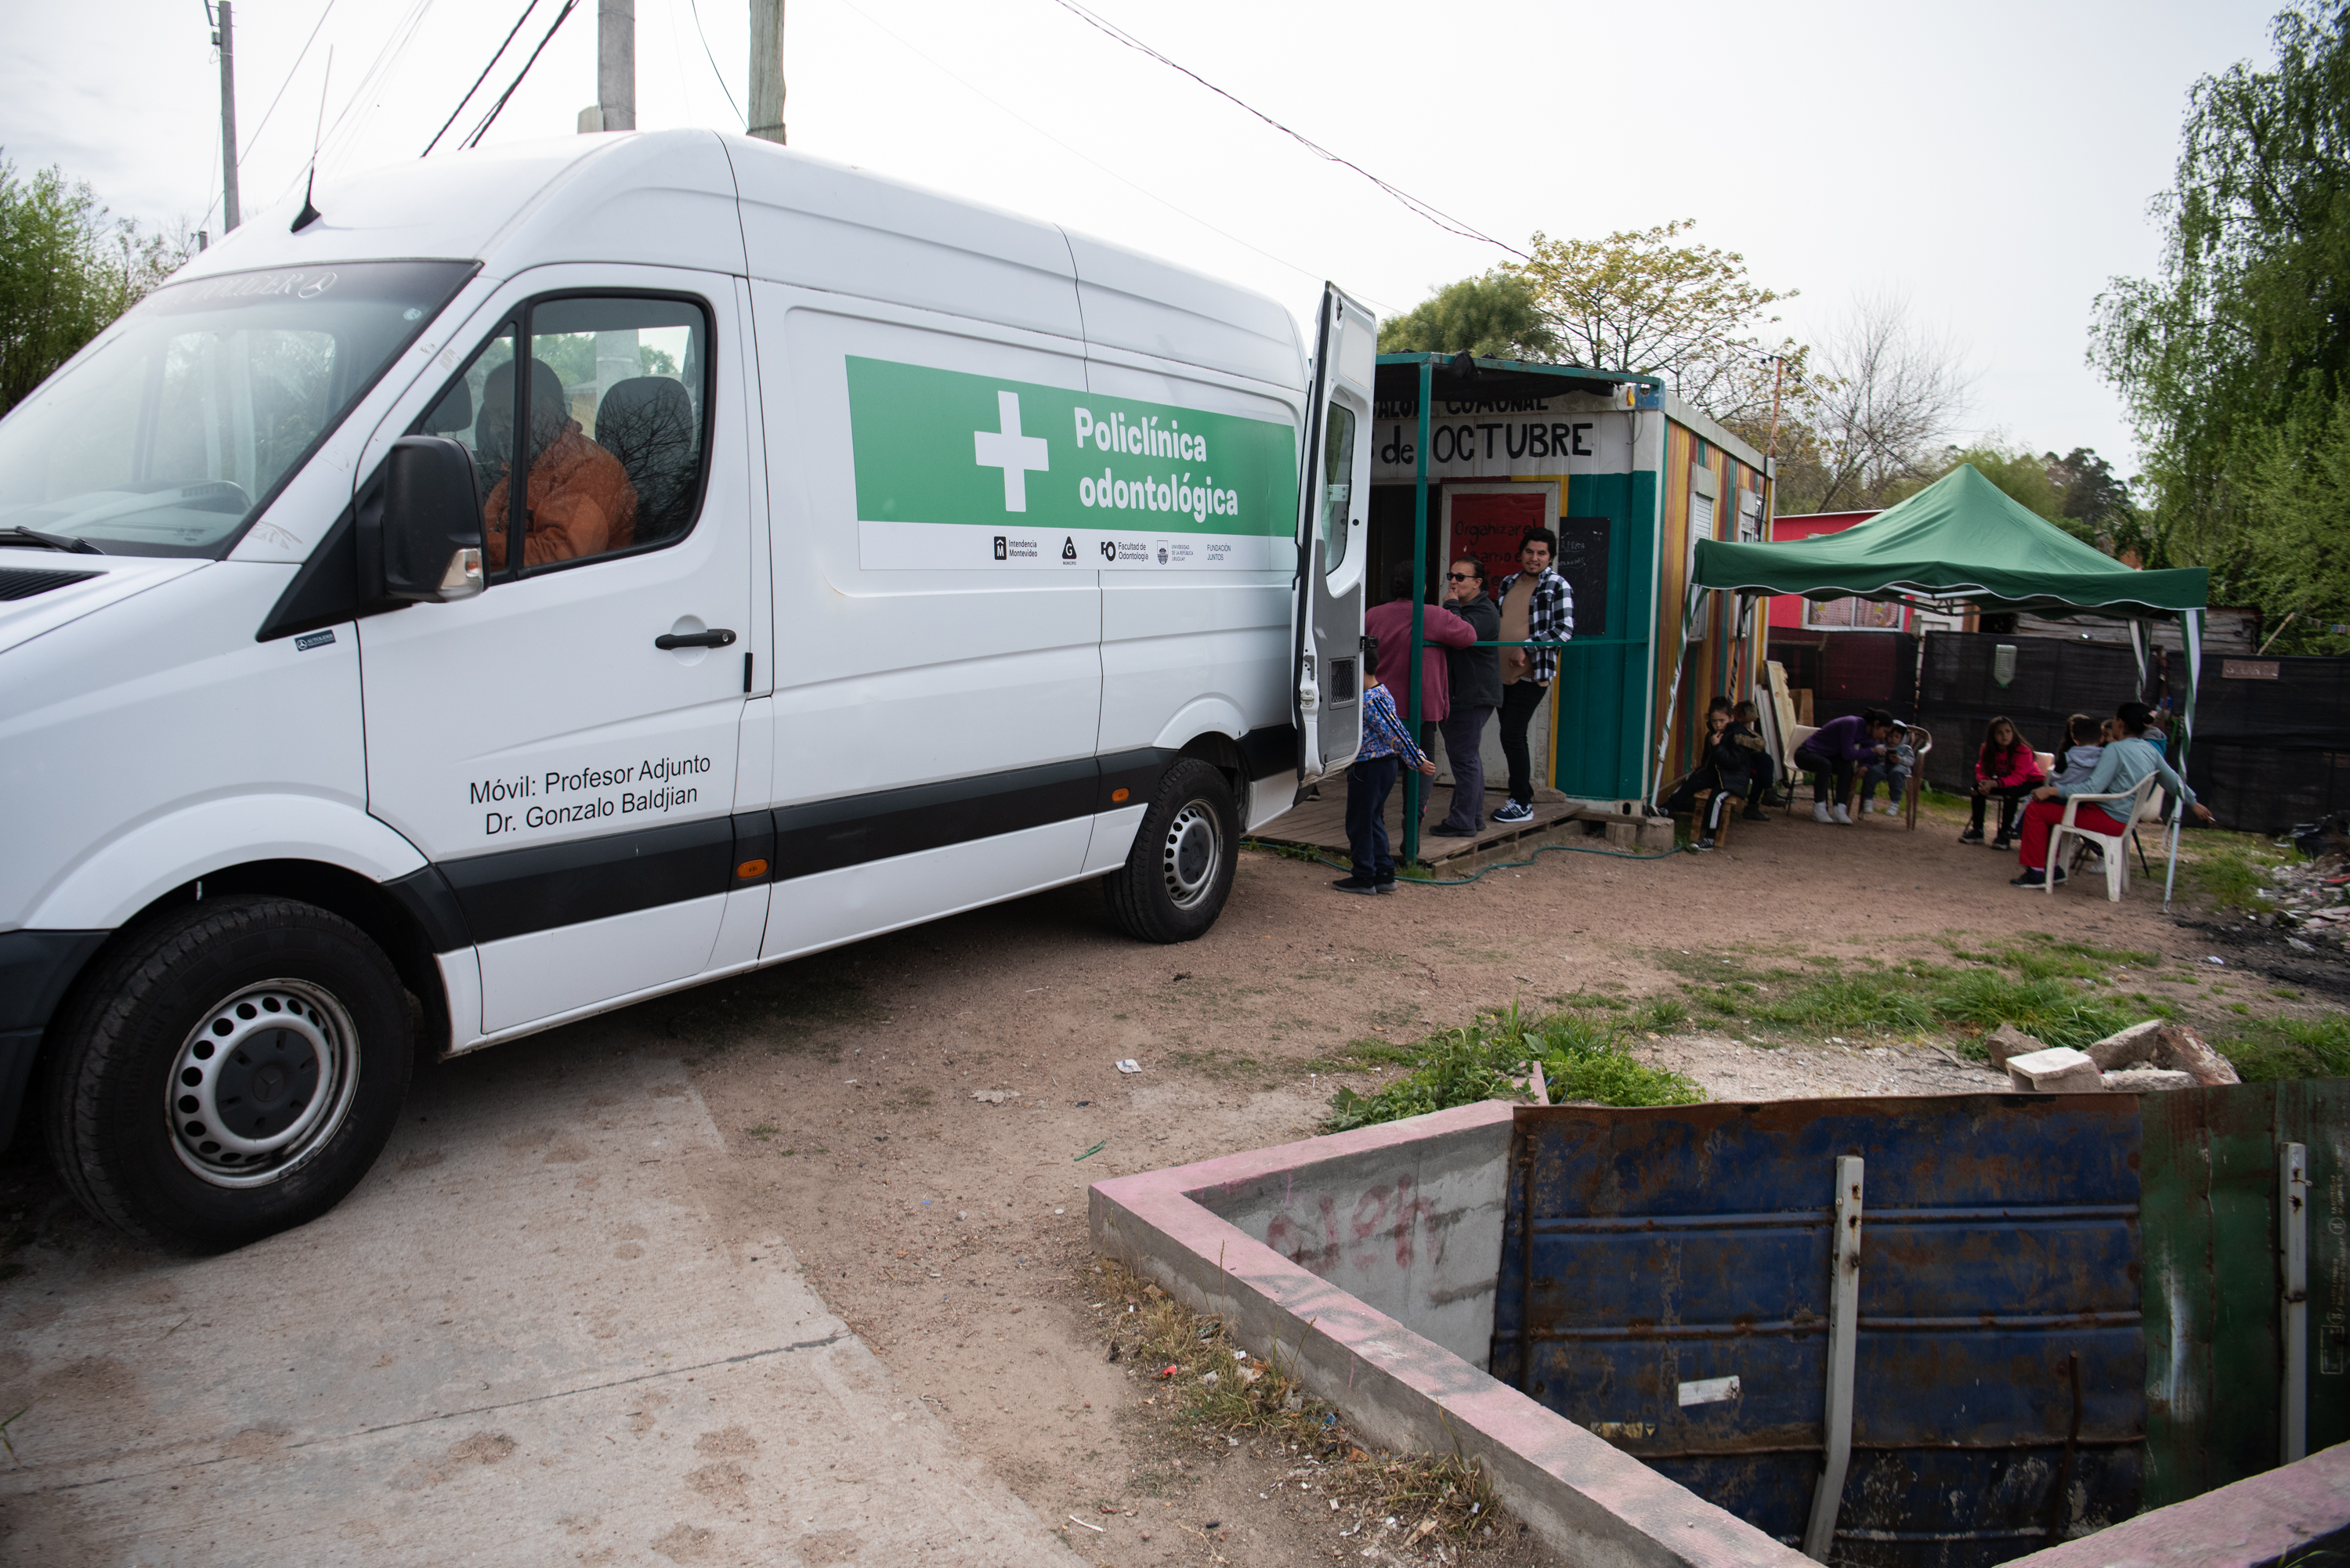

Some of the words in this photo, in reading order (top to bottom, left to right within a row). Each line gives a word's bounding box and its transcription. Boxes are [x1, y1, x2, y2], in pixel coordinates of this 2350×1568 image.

[1074, 406, 1207, 462] Policlínica
[1381, 425, 1414, 465] de
[1433, 423, 1593, 464] OCTUBRE
[1079, 468, 1238, 523] odontológica
[1065, 543, 1073, 556] G
[1118, 542, 1139, 551] Facultad
[1140, 542, 1146, 551] de
[1206, 543, 1231, 552] FUNDACIÓN
[1455, 520, 1522, 546] Organizar
[1119, 551, 1149, 562] Odontología
[470, 775, 536, 804] Móvil:
[545, 767, 634, 794] Profesor
[638, 754, 711, 783] Adjunto
[486, 812, 517, 835] Dr.
[526, 797, 614, 828] Gonzalo
[621, 786, 698, 812] Baldjian
